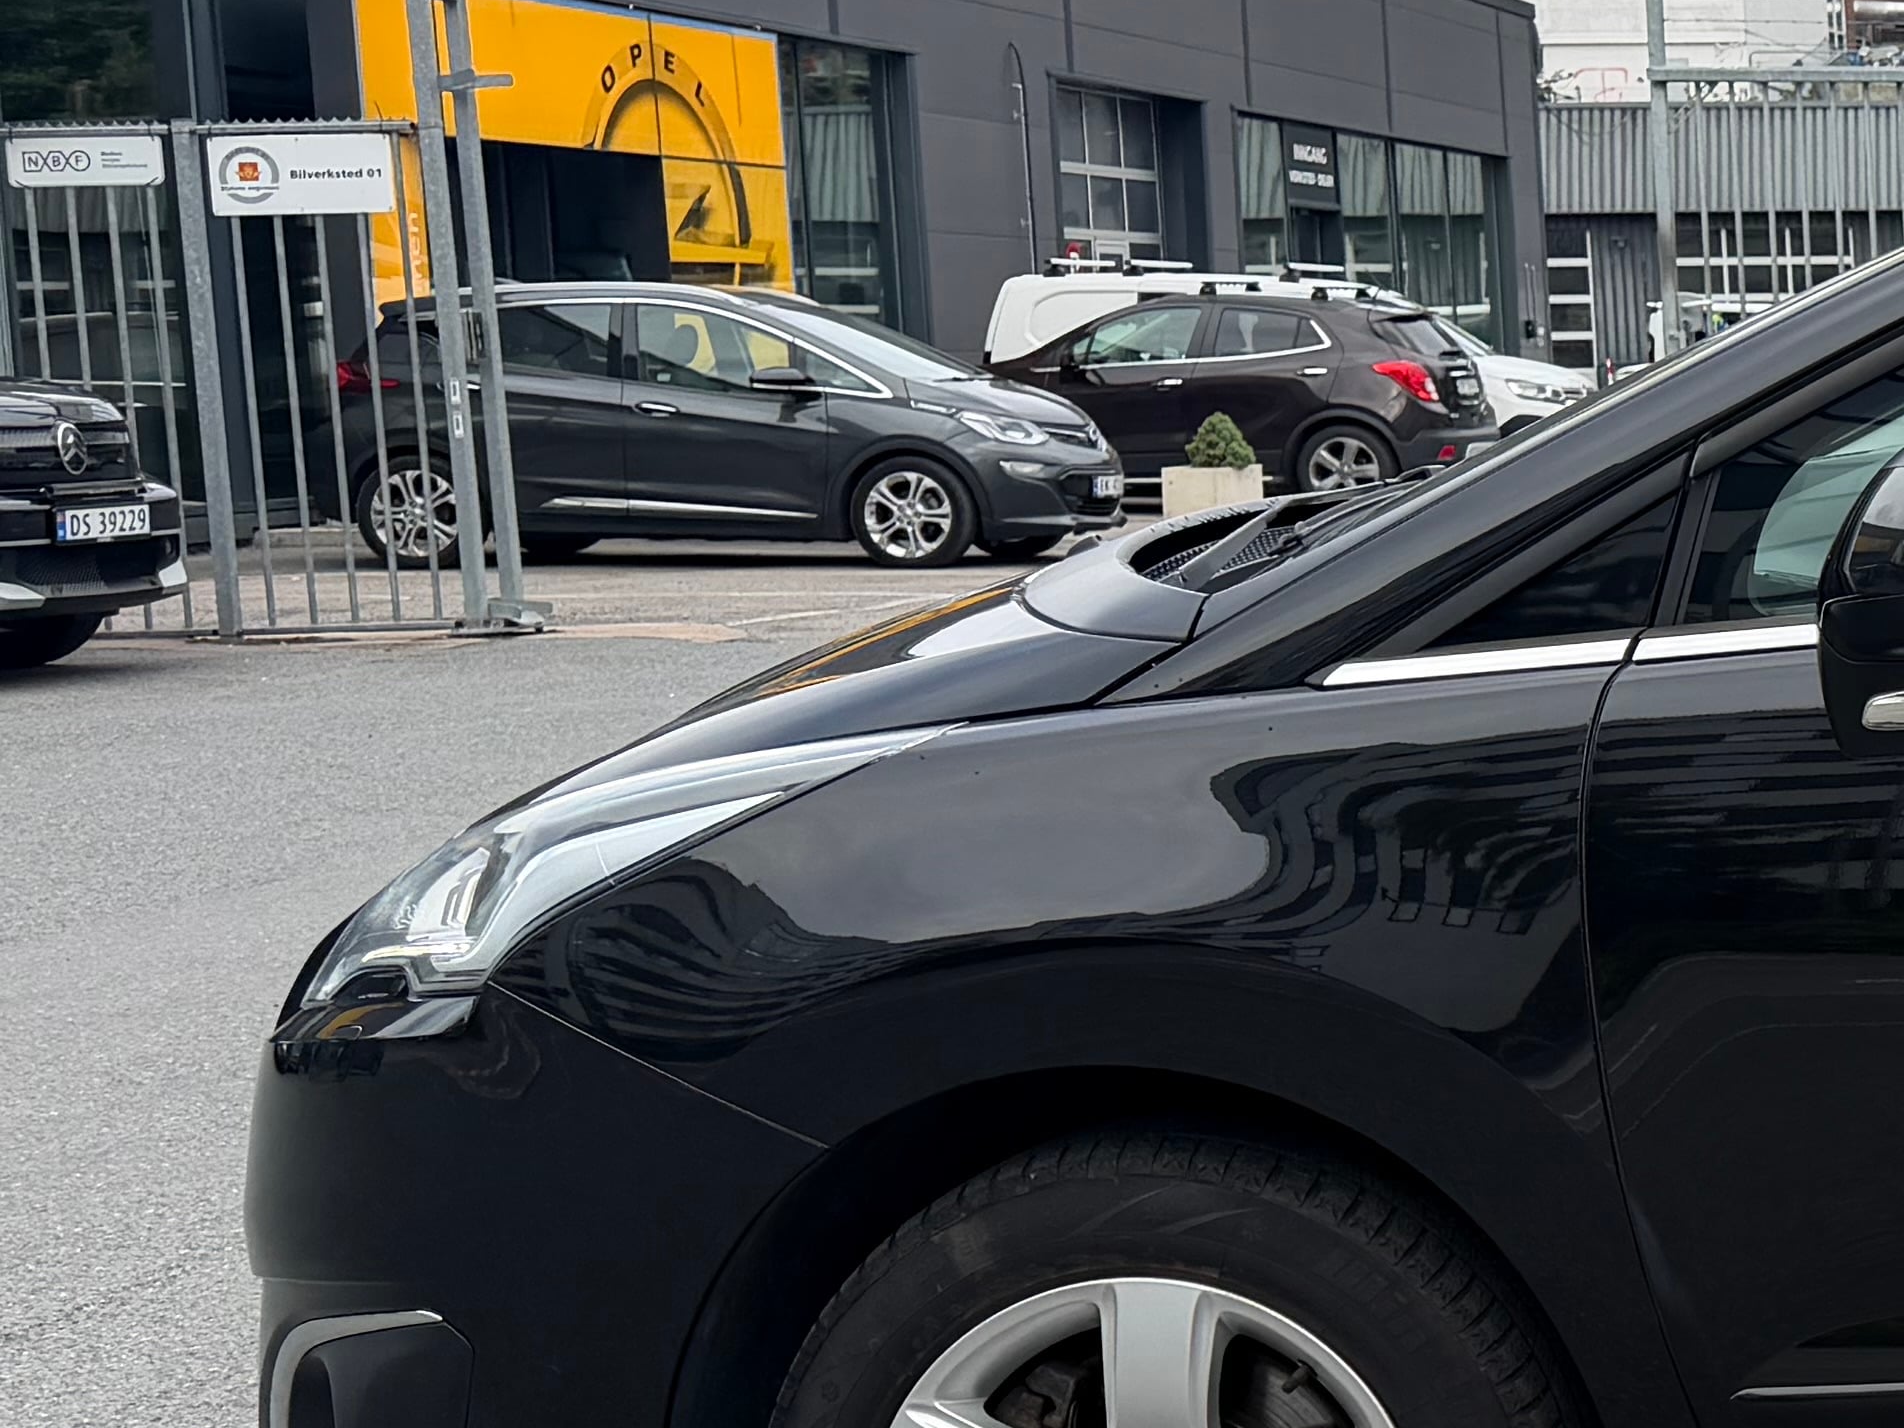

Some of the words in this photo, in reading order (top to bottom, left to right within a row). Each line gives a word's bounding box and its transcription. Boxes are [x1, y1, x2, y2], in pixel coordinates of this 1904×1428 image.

[600, 43, 705, 107] OPEL
[25, 152, 87, 170] NBF
[290, 168, 363, 180] Bilverksted
[367, 168, 382, 178] 01
[70, 513, 91, 537] DS
[99, 508, 146, 535] 39229
